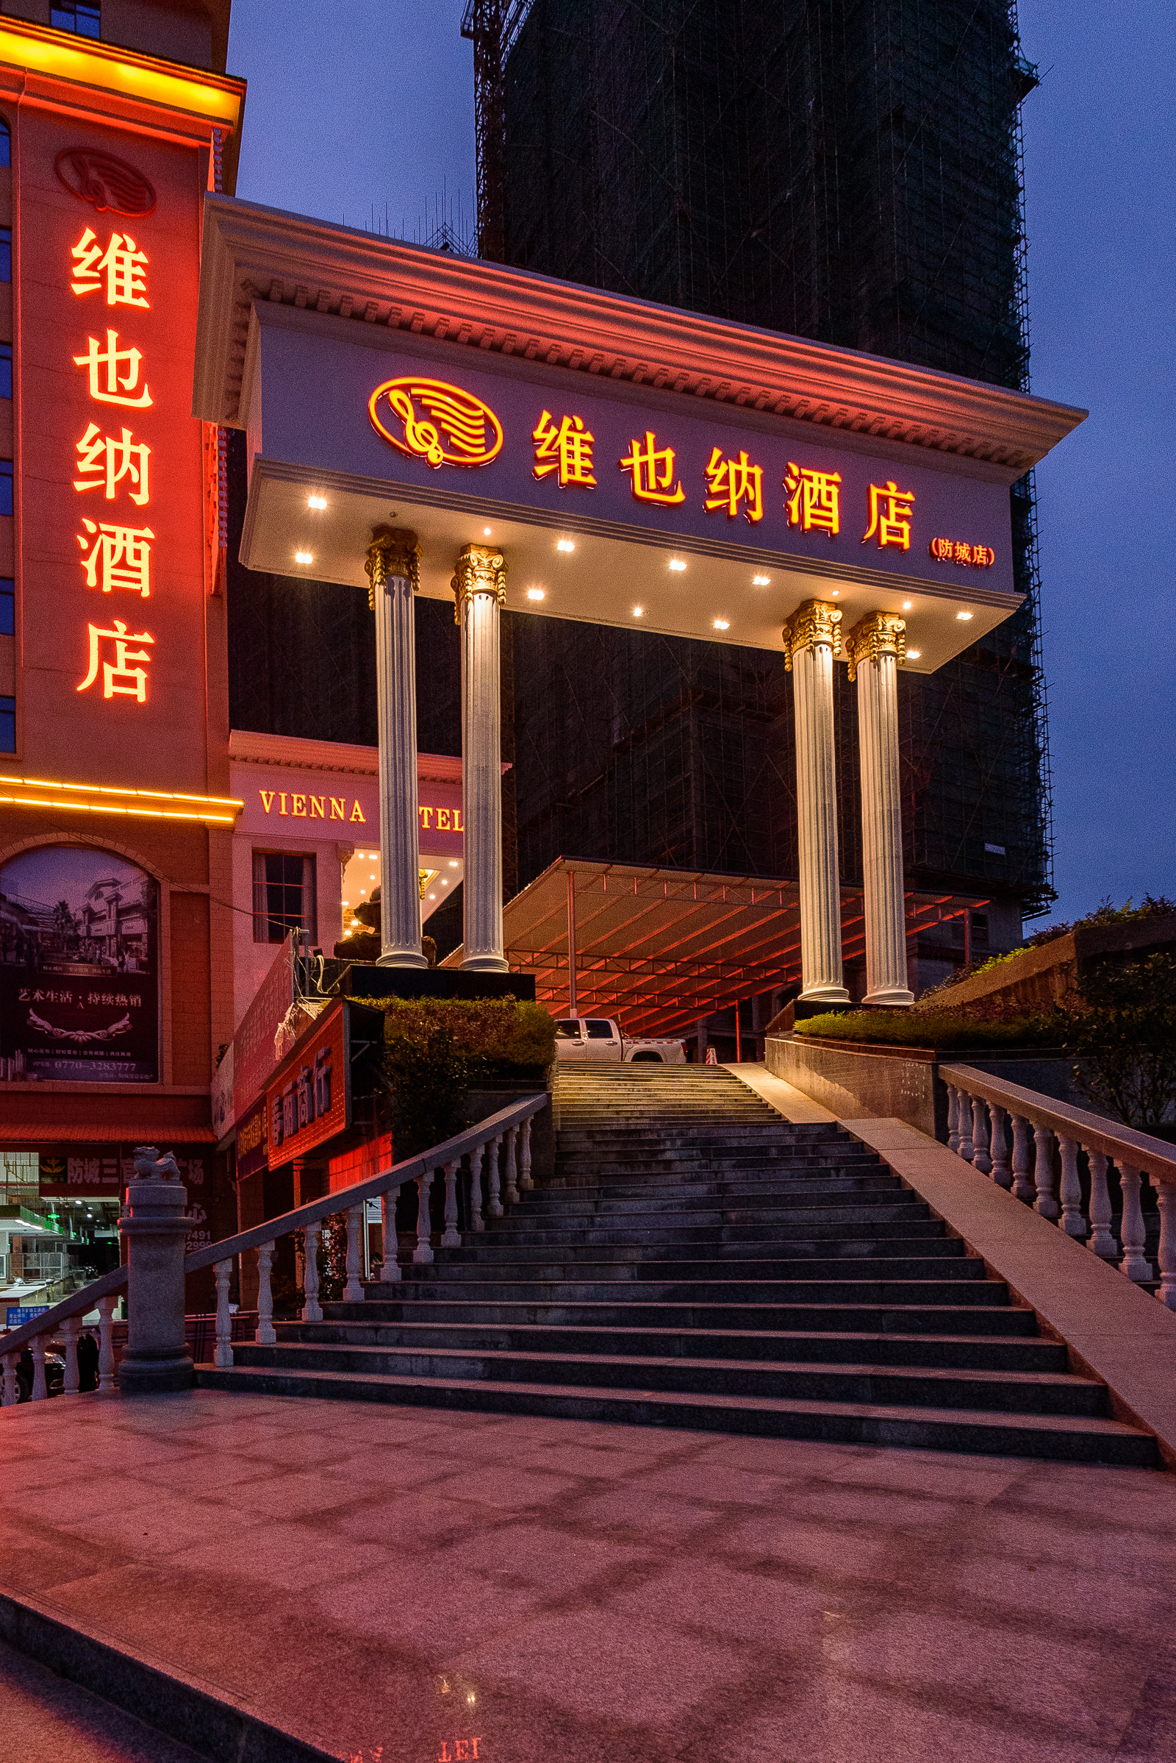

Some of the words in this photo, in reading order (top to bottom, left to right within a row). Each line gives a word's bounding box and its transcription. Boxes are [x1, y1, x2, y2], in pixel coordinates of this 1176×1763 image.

[70, 226, 155, 703] 维也纳酒店
[530, 408, 916, 551] 维也纳酒店
[258, 790, 367, 823] VIENNA
[418, 805, 464, 833] TEL
